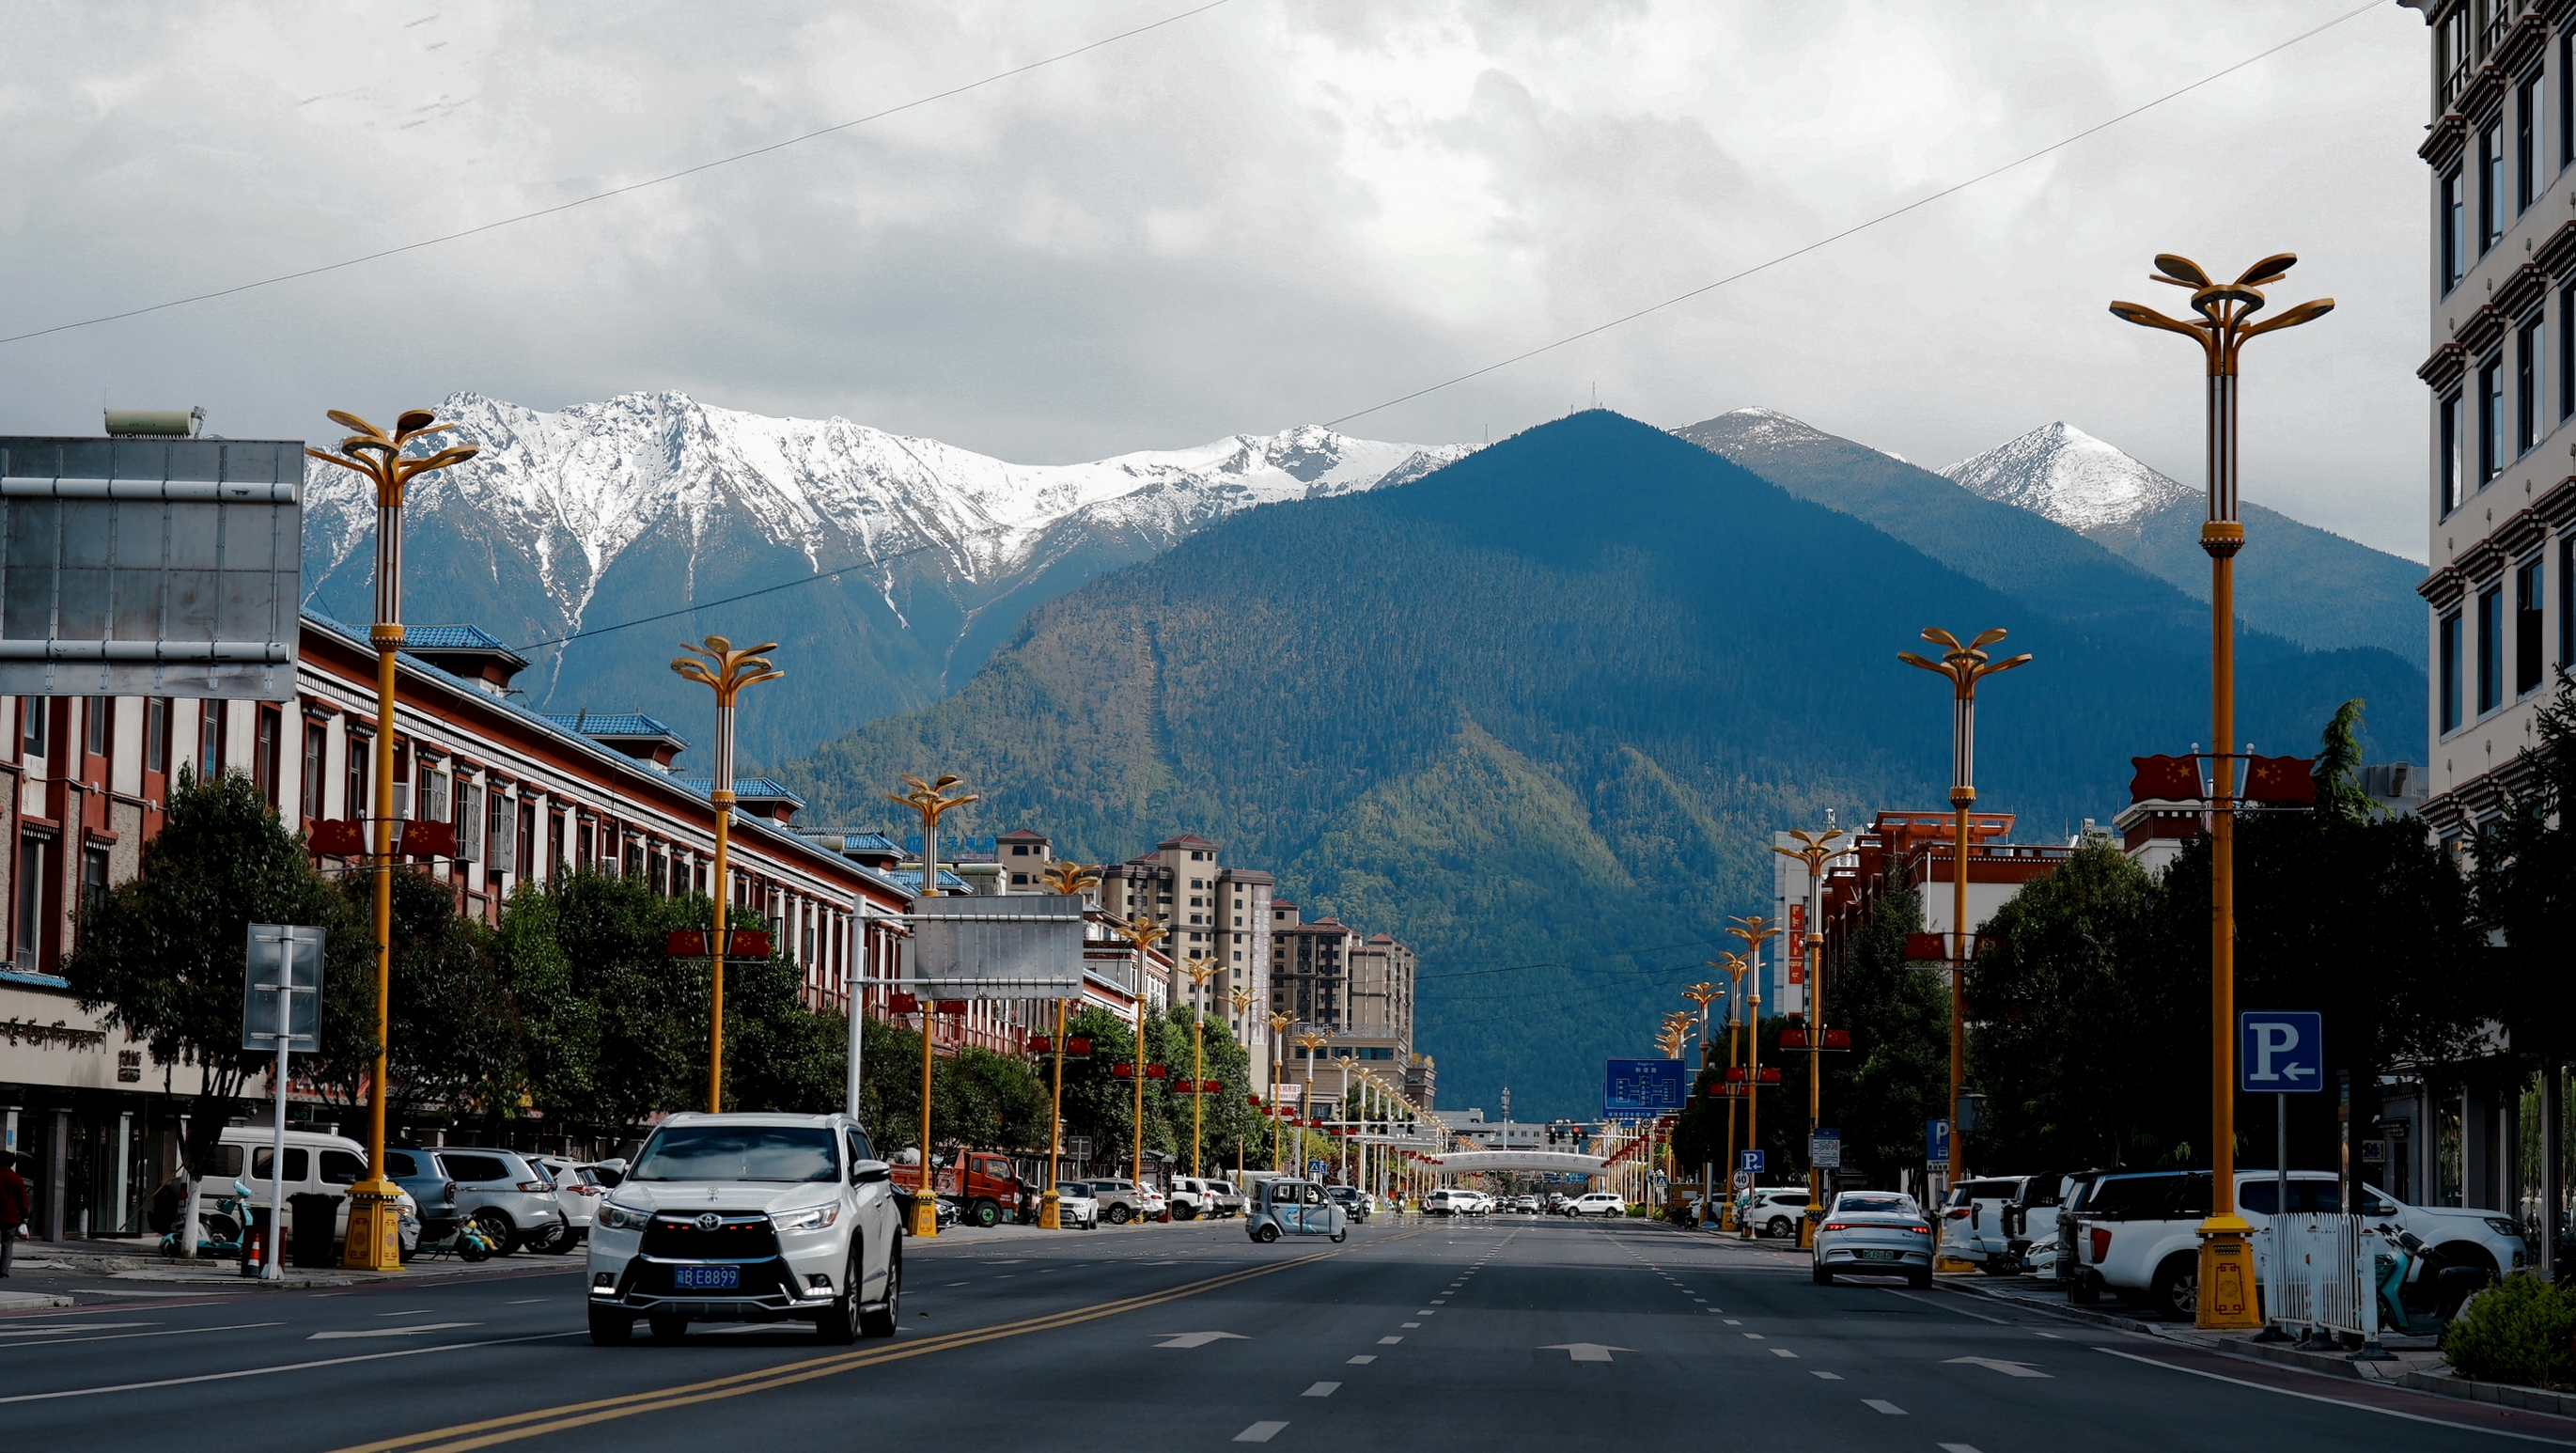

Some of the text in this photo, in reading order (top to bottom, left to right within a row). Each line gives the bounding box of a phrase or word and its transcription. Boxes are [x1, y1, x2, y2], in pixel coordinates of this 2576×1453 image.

[2249, 1023, 2300, 1081] P
[1936, 1121, 1949, 1145] P
[1743, 1152, 1758, 1170] P
[1735, 1175, 1747, 1184] 40
